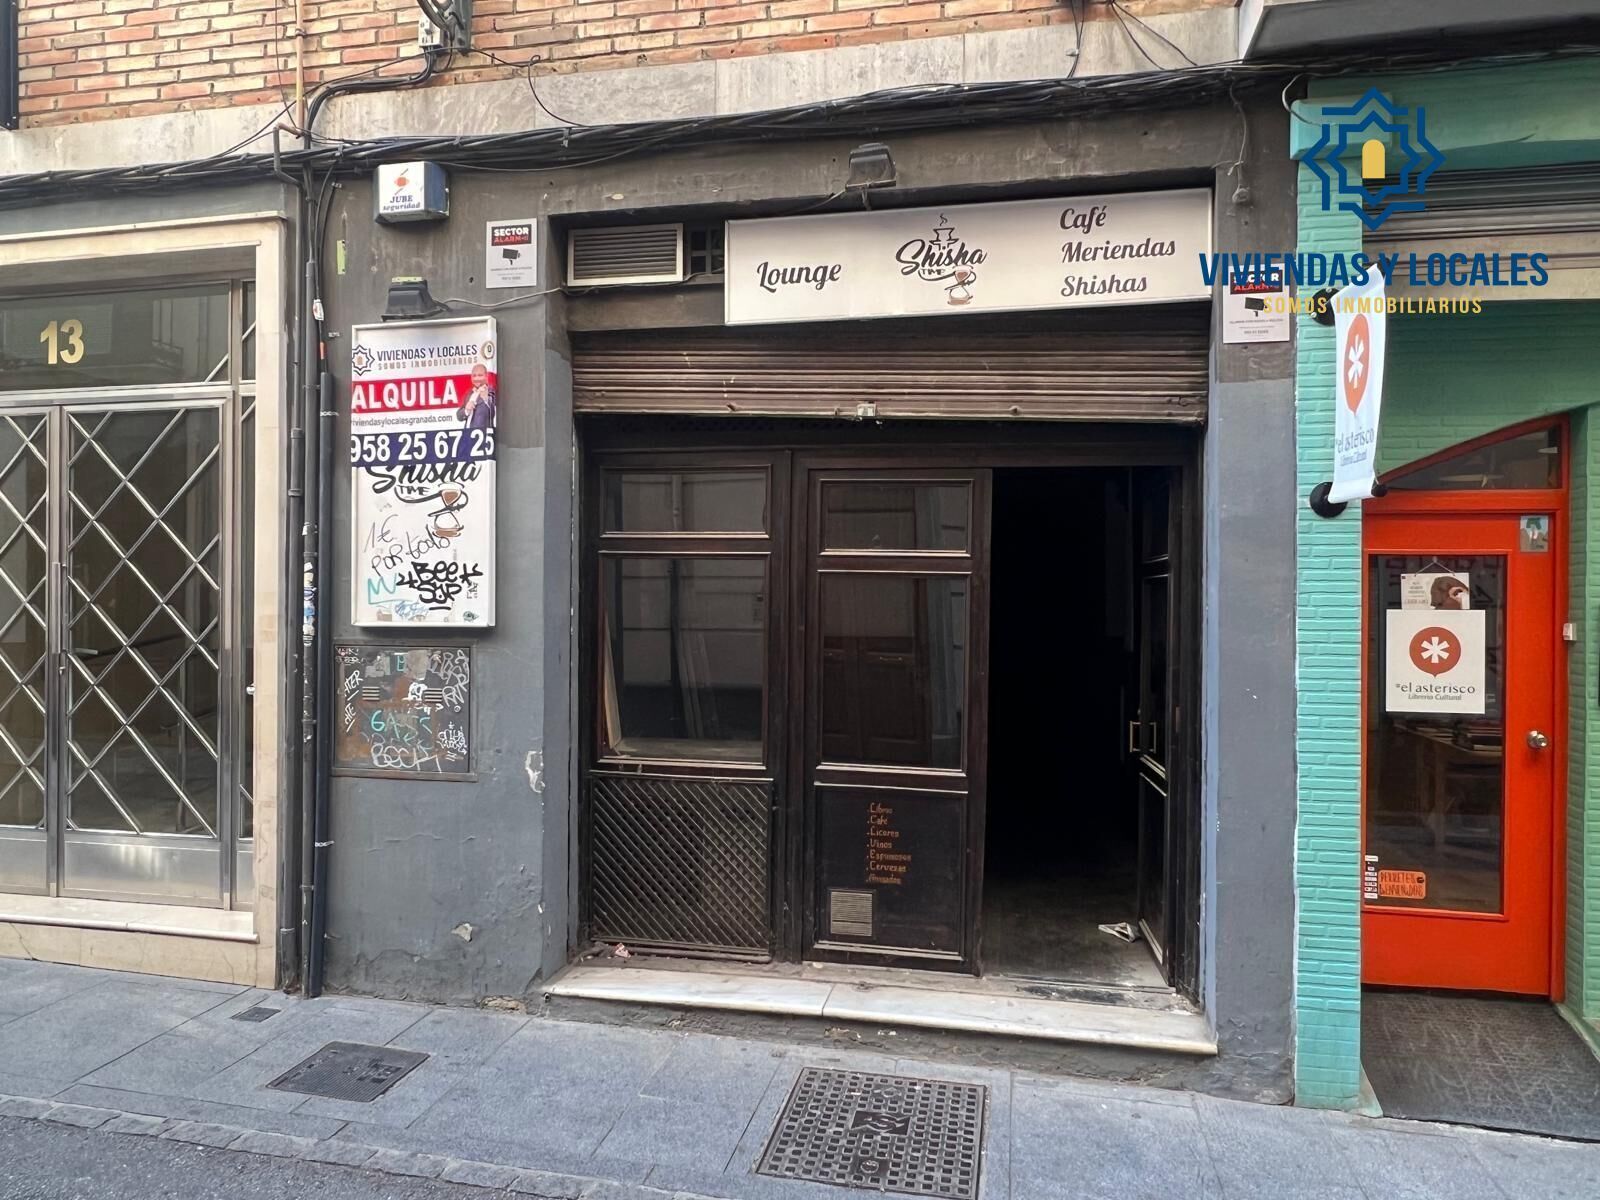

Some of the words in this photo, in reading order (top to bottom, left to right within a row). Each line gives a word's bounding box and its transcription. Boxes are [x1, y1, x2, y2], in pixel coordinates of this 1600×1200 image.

[494, 227, 529, 236] SECTOR
[1060, 206, 1107, 234] Café
[895, 239, 988, 275] Shisha
[1060, 238, 1176, 264] Meriendas
[756, 261, 843, 293] Lounge
[1060, 275, 1148, 298] Shishas
[40, 319, 85, 364] 13
[377, 348, 426, 361] VIVIENDAS
[428, 348, 436, 358] Y
[437, 345, 478, 357] LOCALES
[352, 379, 459, 410] ALQUILA
[351, 434, 391, 463] 958
[398, 432, 428, 461] 25
[434, 430, 463, 459] 67
[470, 428, 494, 457] 25
[399, 485, 431, 496] TIME
[1415, 684, 1476, 693] asterisco
